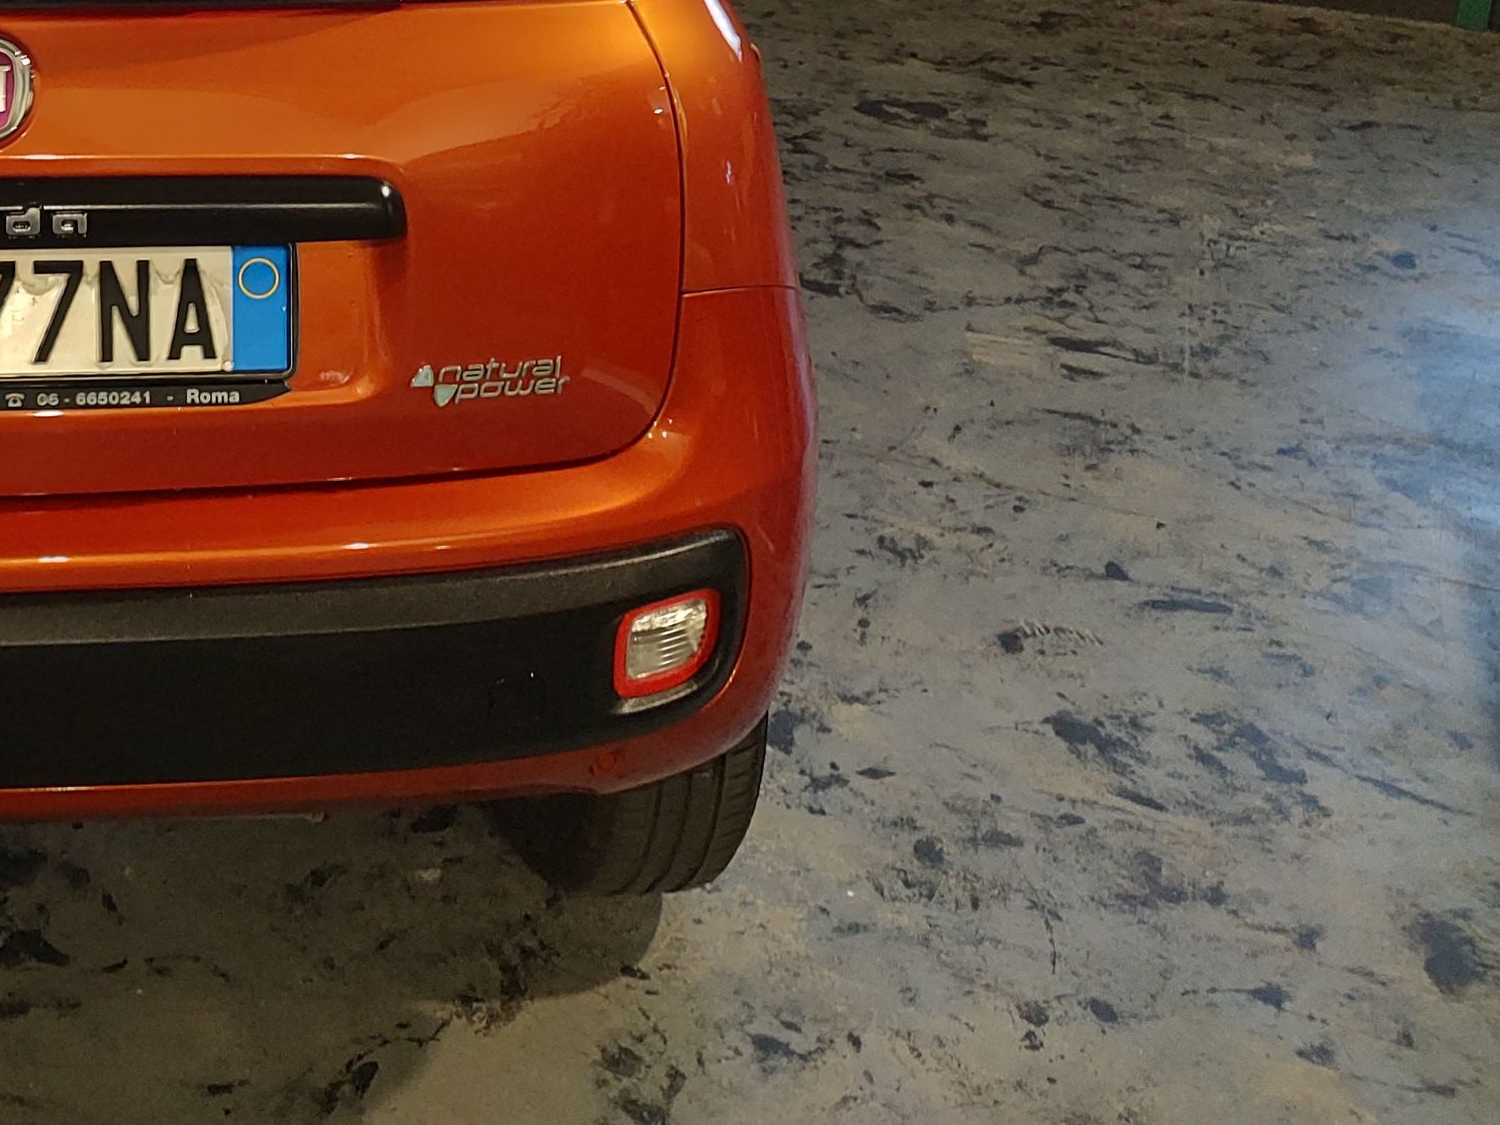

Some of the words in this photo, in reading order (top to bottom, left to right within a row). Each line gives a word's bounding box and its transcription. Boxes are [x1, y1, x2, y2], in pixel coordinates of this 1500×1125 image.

[438, 355, 562, 383] natural
[186, 387, 240, 404] Roma
[454, 375, 571, 405] power
